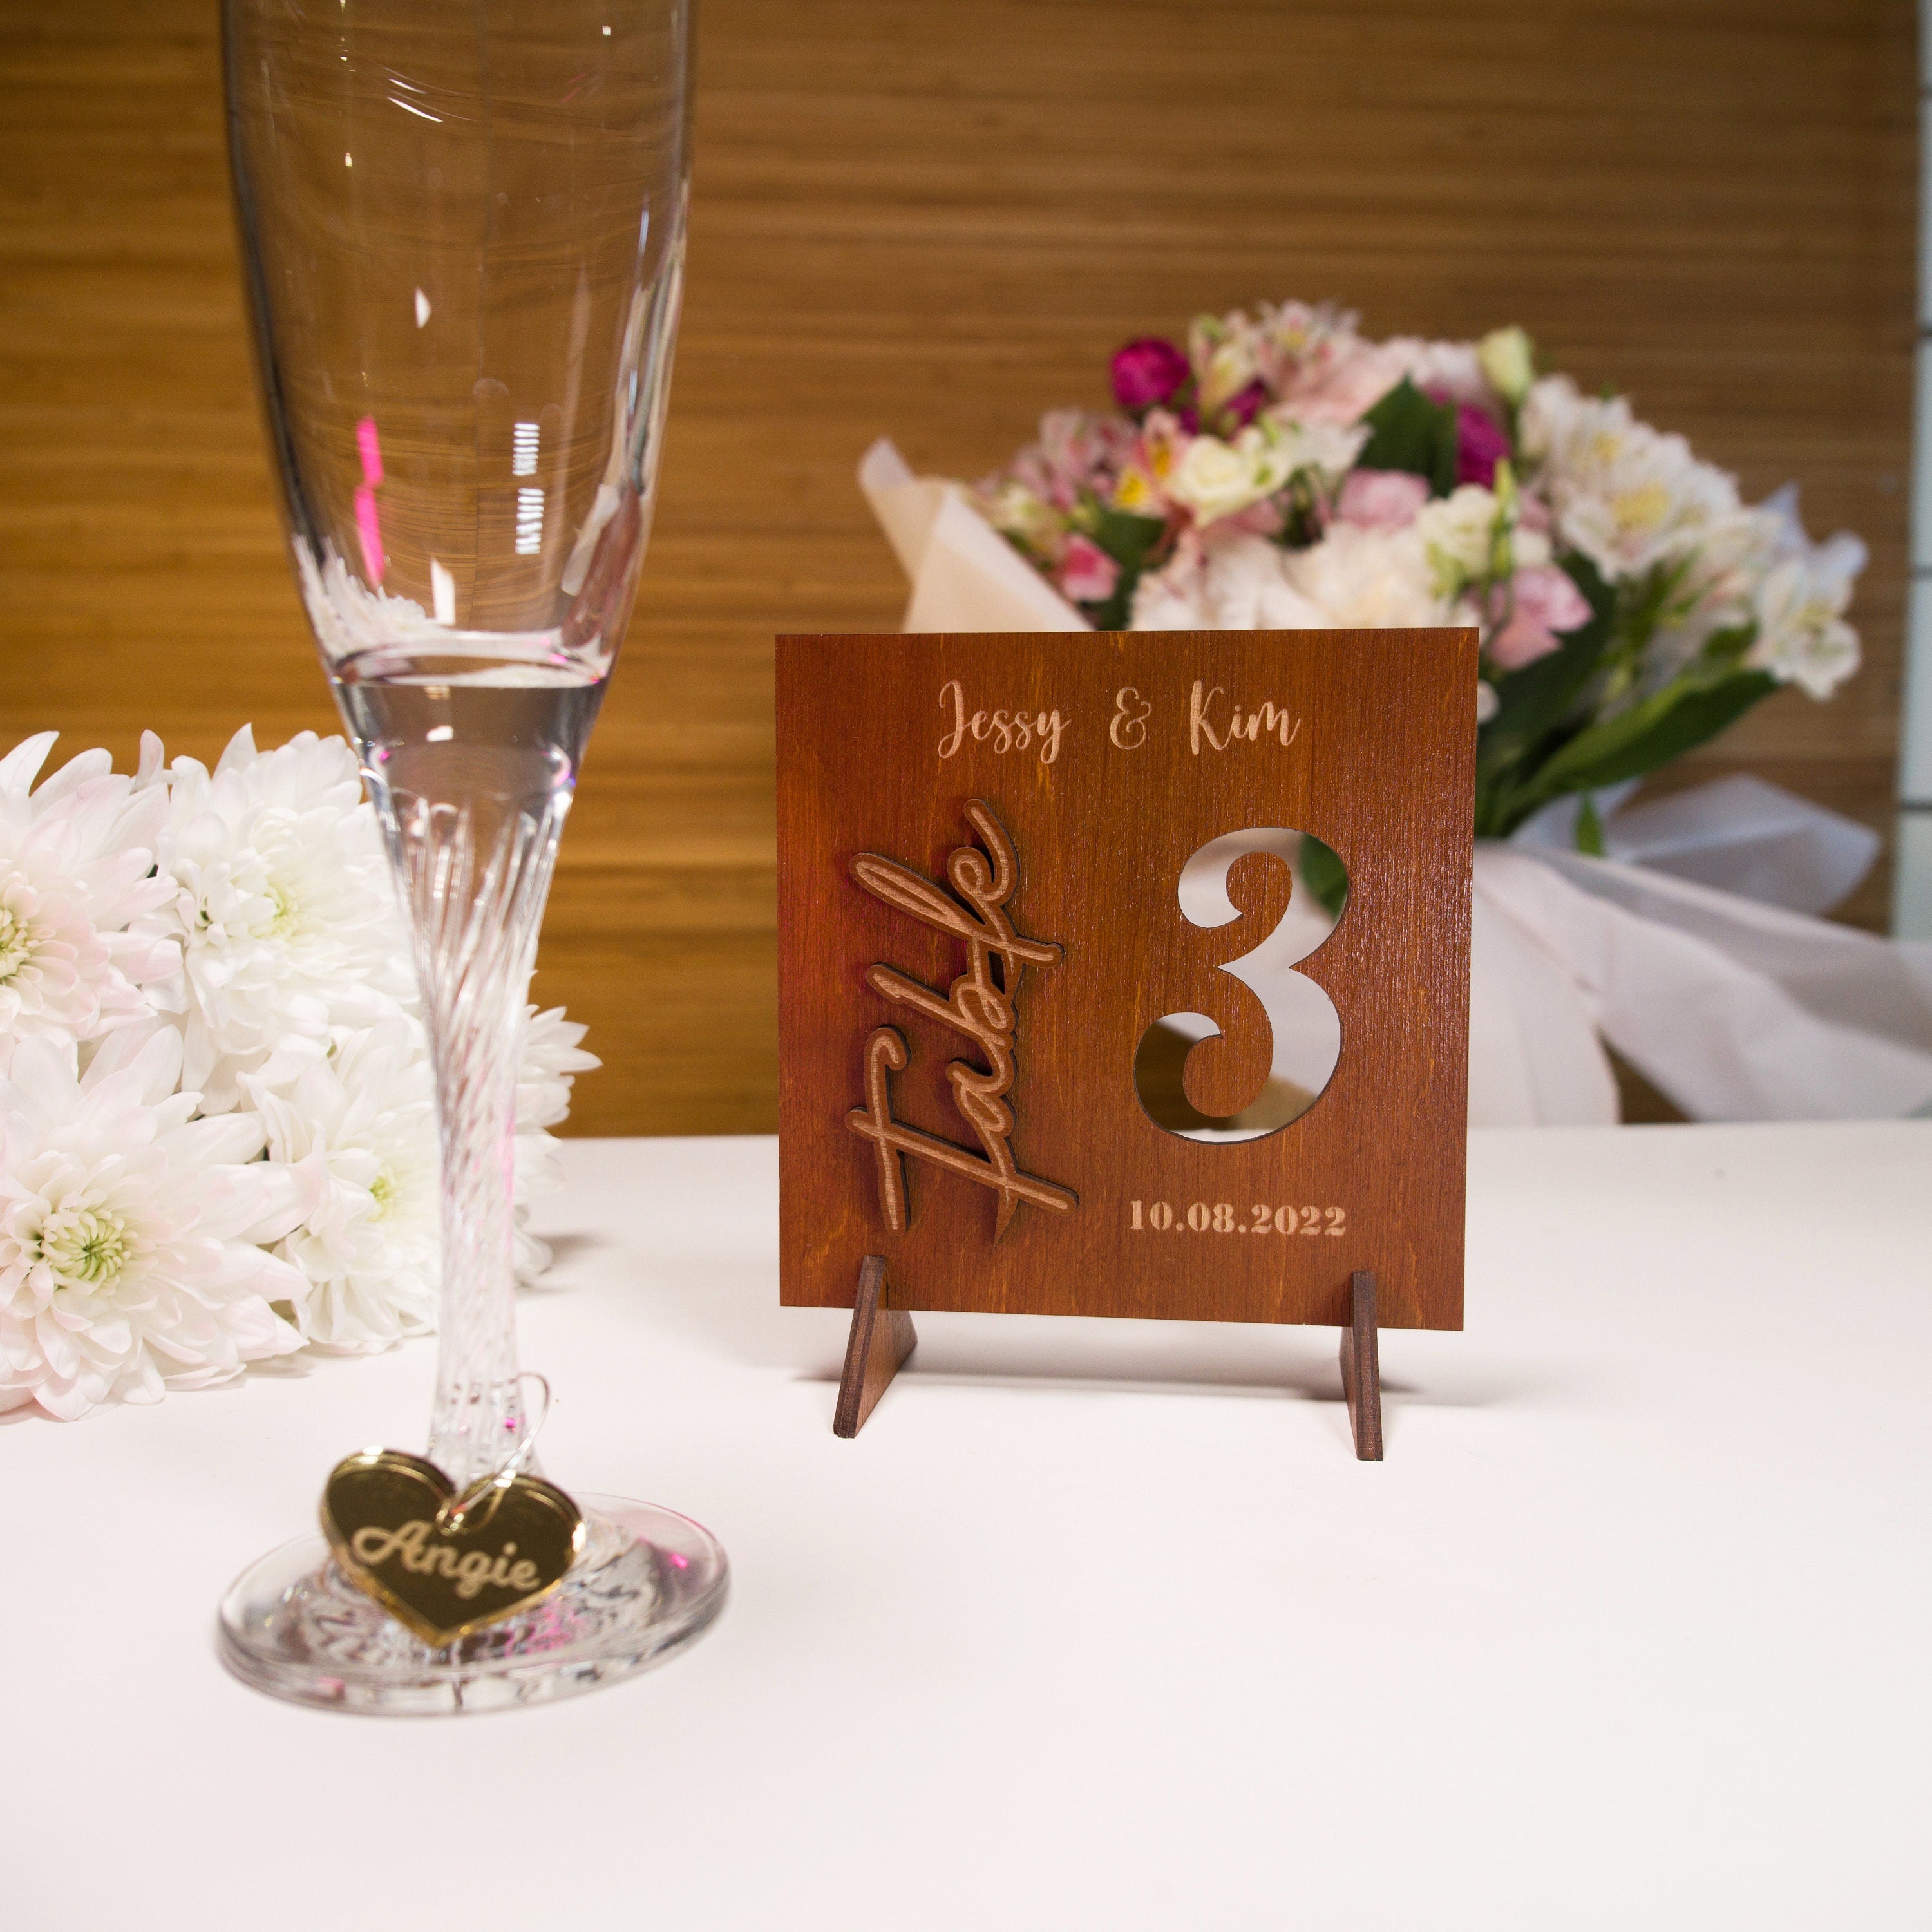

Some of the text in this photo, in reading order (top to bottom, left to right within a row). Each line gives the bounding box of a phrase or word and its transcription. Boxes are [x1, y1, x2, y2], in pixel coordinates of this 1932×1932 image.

[937, 679, 1301, 764] Jessy & Kim
[1133, 826, 1350, 1144] 3
[1130, 1200, 1347, 1236] 10.08.2022
[351, 1519, 542, 1600] Angie
